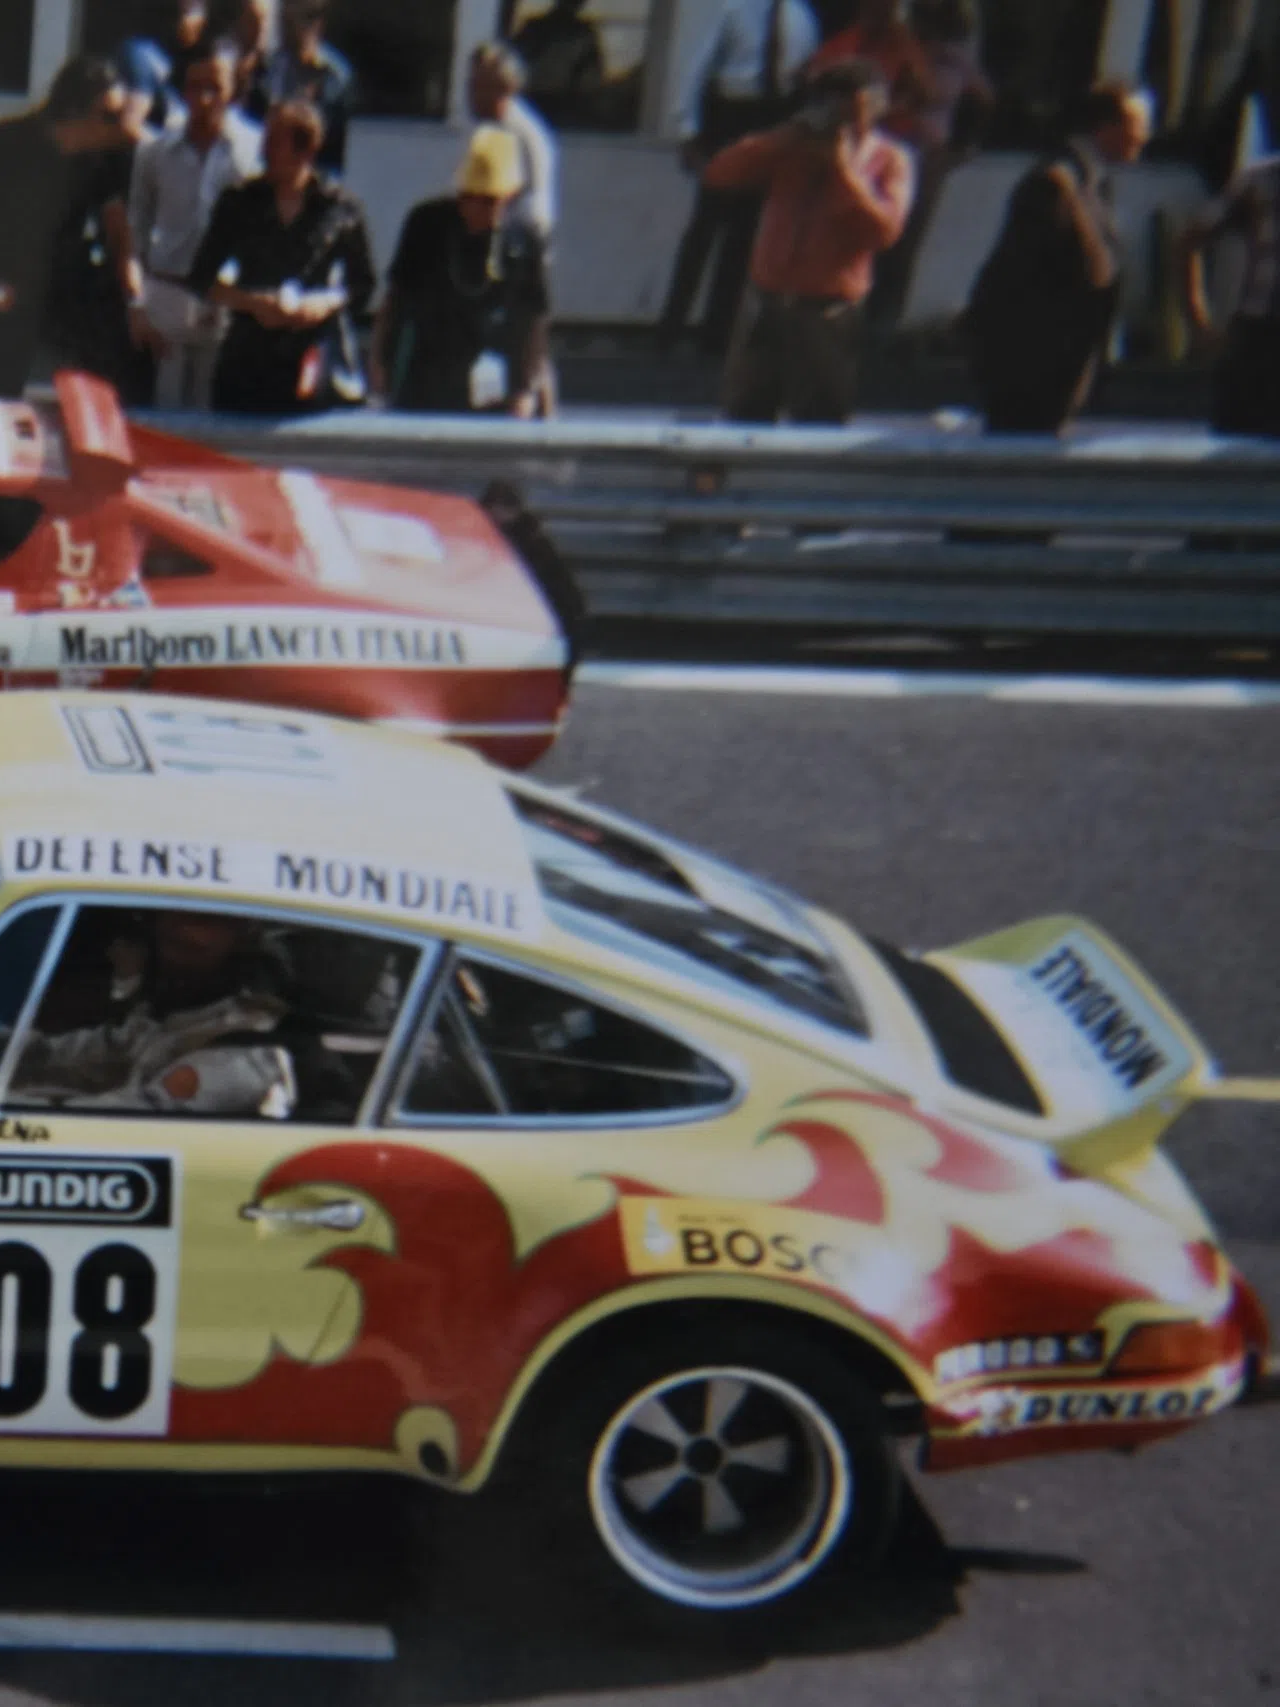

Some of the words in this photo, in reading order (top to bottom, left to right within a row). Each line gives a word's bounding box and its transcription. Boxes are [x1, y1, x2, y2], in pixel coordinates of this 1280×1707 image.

[58, 625, 217, 665] Marlboro
[224, 623, 347, 661] LANCIA
[14, 836, 232, 884] DEFENSE
[273, 851, 524, 931] MONDIALE
[680, 1228, 842, 1284] BOSC
